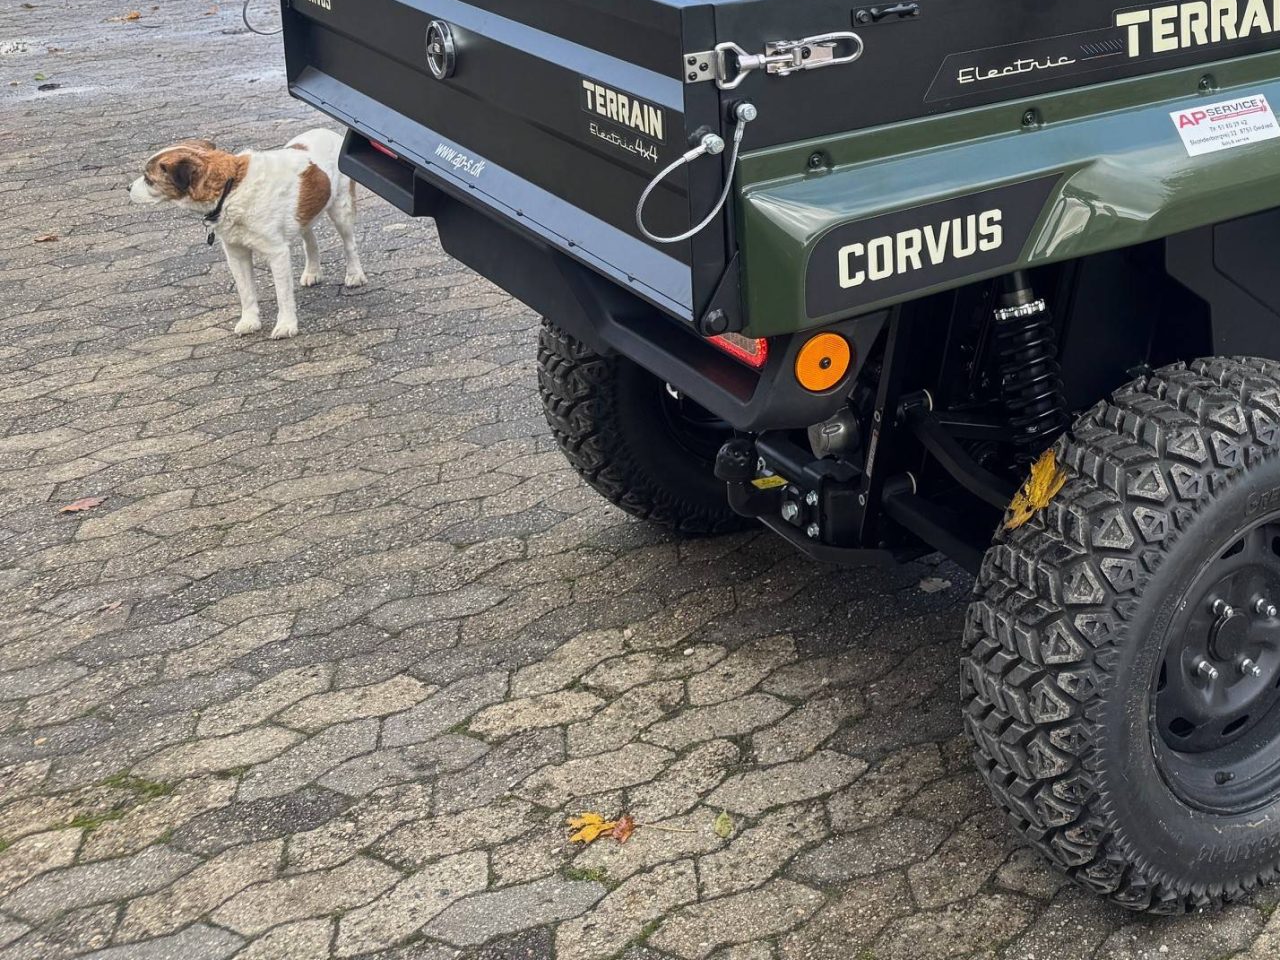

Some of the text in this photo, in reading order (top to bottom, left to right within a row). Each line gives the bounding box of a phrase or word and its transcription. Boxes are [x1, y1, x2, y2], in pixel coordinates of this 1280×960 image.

[957, 54, 1076, 85] Electric
[582, 80, 663, 140] TERRAIN
[1178, 99, 1259, 129] AP SERVICE
[434, 142, 486, 178] www.ap-s.dk
[589, 122, 658, 164] Electric 4x4
[837, 208, 1003, 290] CORVUS
